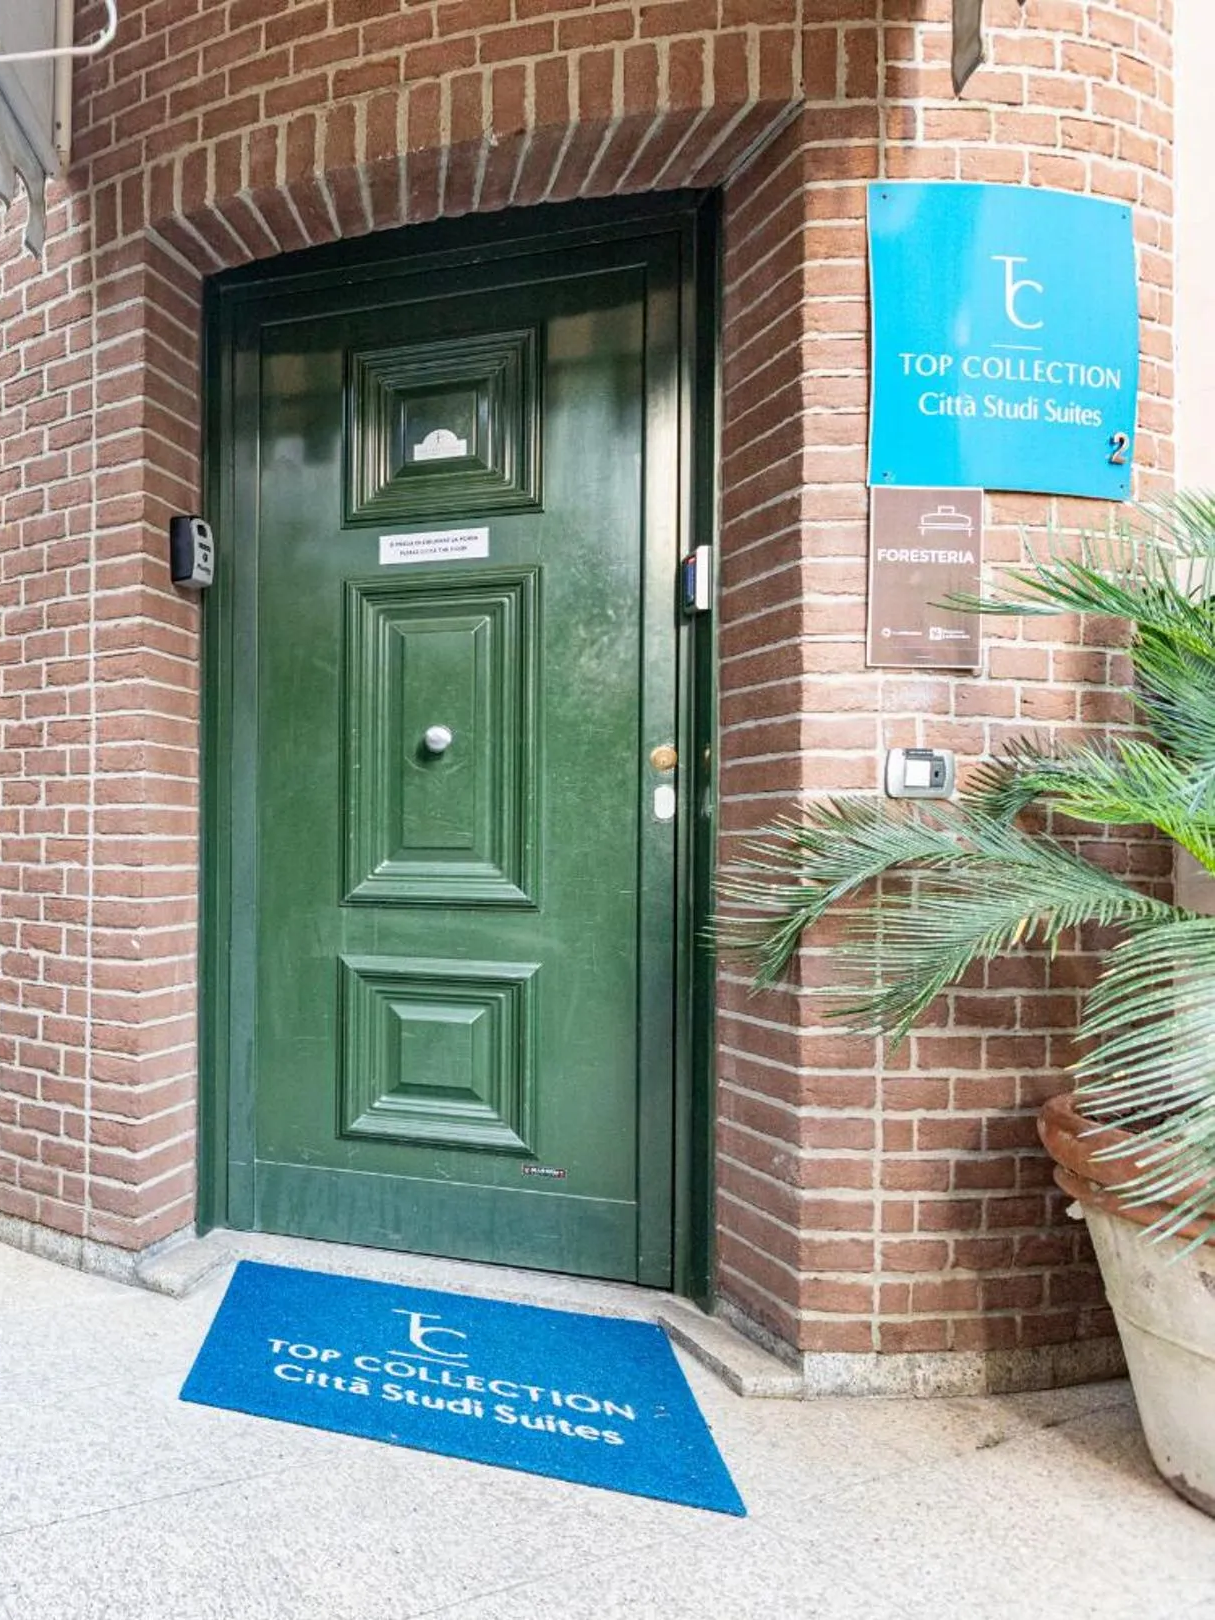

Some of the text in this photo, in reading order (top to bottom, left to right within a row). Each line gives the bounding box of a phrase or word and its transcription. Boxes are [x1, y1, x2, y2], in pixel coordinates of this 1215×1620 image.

[898, 352, 1122, 390] TOP COLLECTION
[918, 392, 1103, 427] Città Studi Suites
[1109, 431, 1130, 465] 2
[877, 548, 975, 565] FORESTERIA
[267, 1338, 635, 1421] TOP COLLECTION
[273, 1363, 626, 1446] Città Studi Suites
